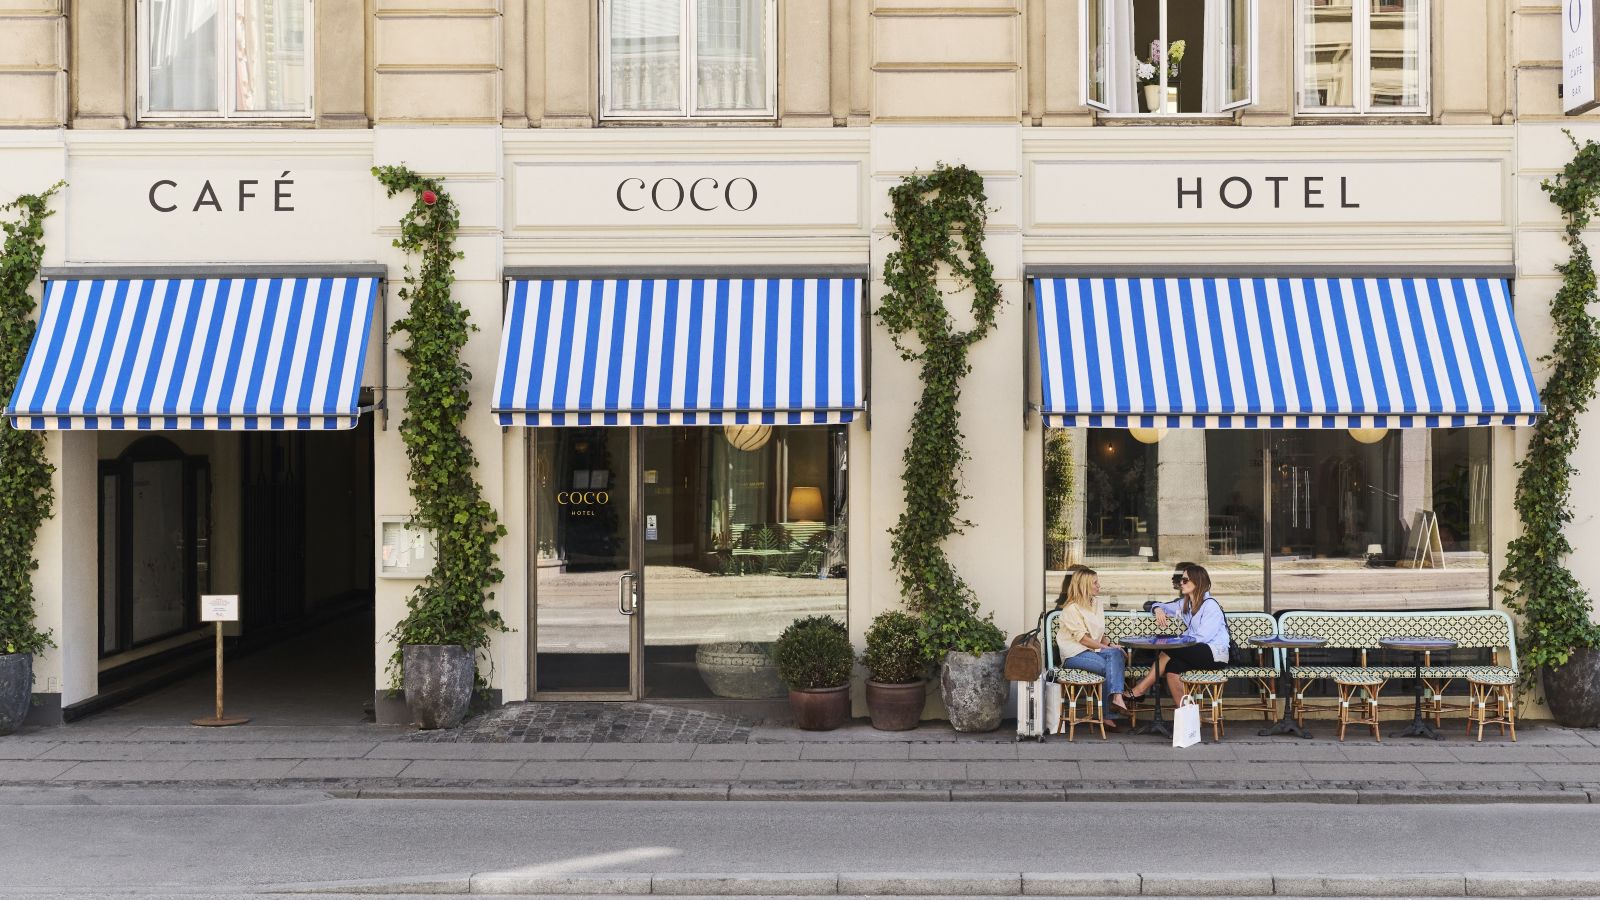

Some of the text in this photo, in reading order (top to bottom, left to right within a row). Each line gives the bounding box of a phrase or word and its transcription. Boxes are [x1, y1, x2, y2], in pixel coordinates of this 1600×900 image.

[1568, 45, 1584, 59] HOTEL
[1571, 85, 1582, 97] BAR
[148, 170, 295, 213] CAFÉ
[616, 177, 758, 212] COCO
[1177, 176, 1360, 210] HOTEL
[557, 491, 609, 505] COCO
